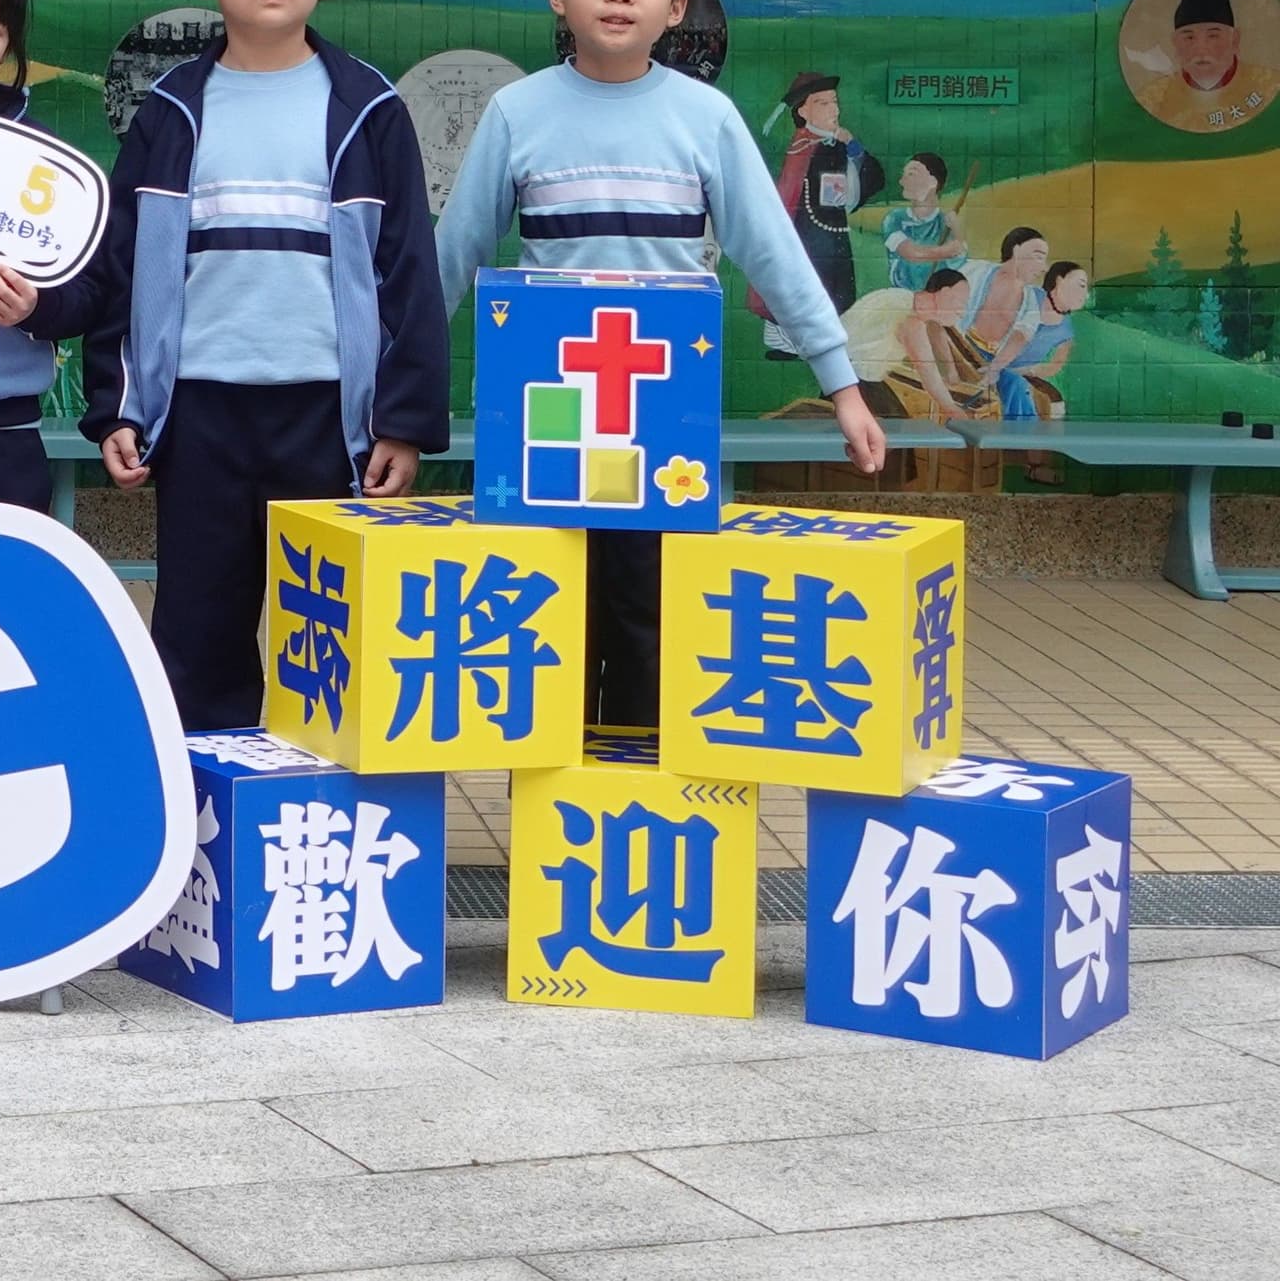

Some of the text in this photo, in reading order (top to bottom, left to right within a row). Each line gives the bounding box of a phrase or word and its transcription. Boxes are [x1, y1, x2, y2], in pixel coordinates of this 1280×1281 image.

[894, 74, 1013, 99] 虎門銷鴉片
[1208, 91, 1265, 126] 明太祖
[19, 163, 60, 216] 5
[385, 553, 873, 757] 將 基
[258, 800, 1018, 1018] 歡 迎 你
